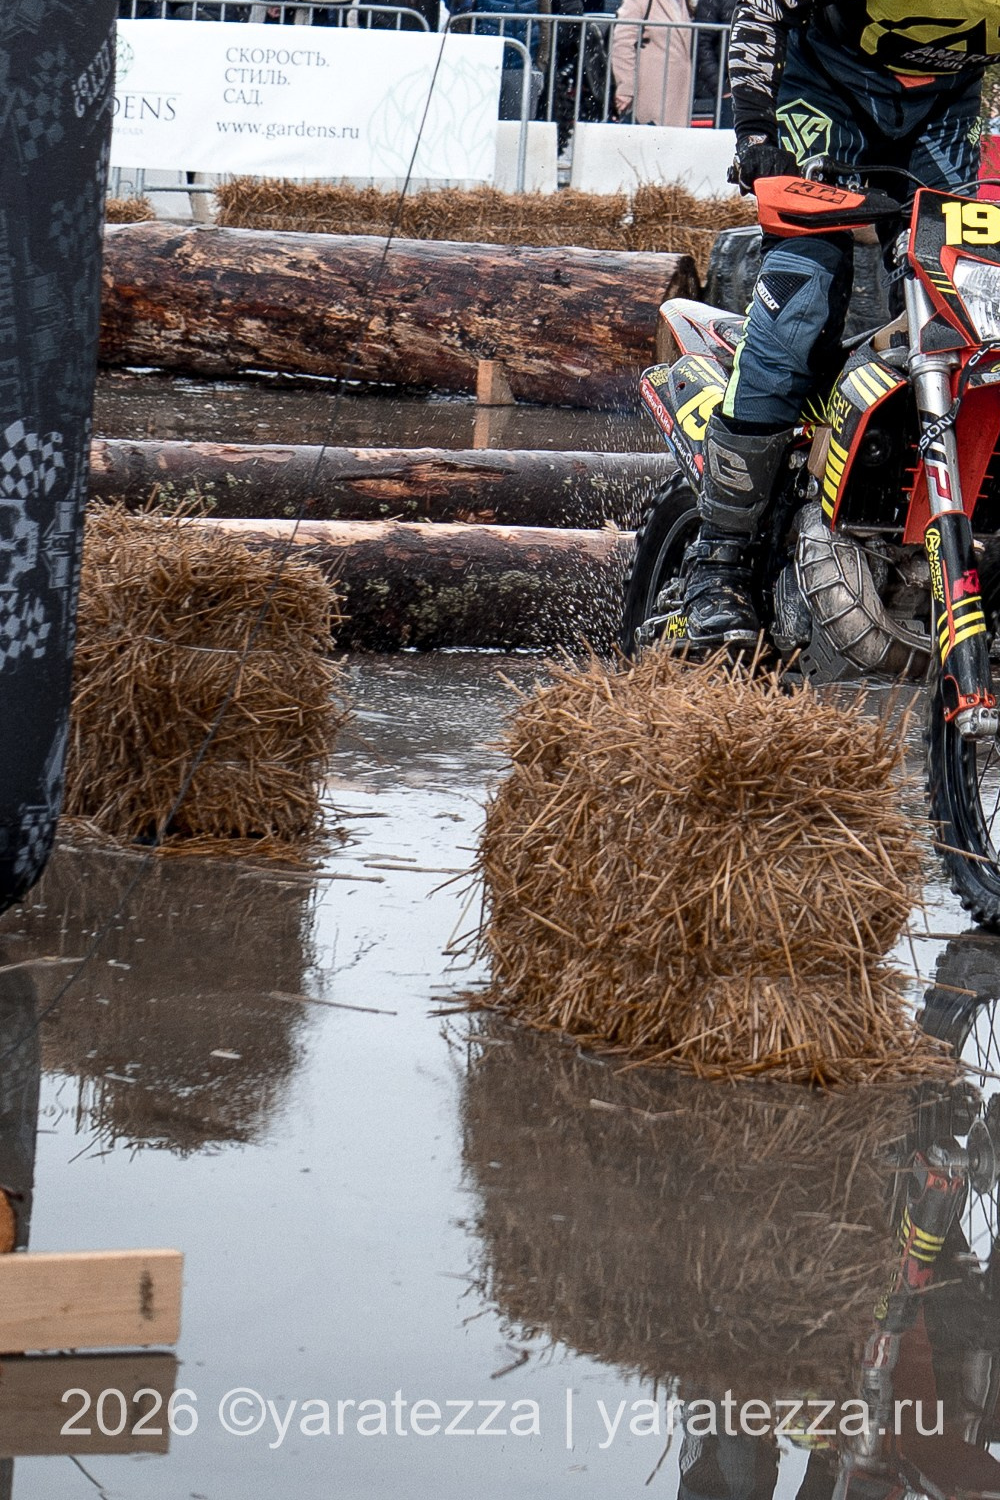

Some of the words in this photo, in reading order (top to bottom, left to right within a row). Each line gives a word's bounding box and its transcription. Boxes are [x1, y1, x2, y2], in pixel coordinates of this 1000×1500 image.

[226, 47, 330, 67] СКОРОСТЬ.
[225, 67, 291, 86] СТИЛЬ.
[223, 88, 264, 107] САД.
[216, 120, 360, 141] www.gardens.ru
[784, 181, 848, 204] KTM
